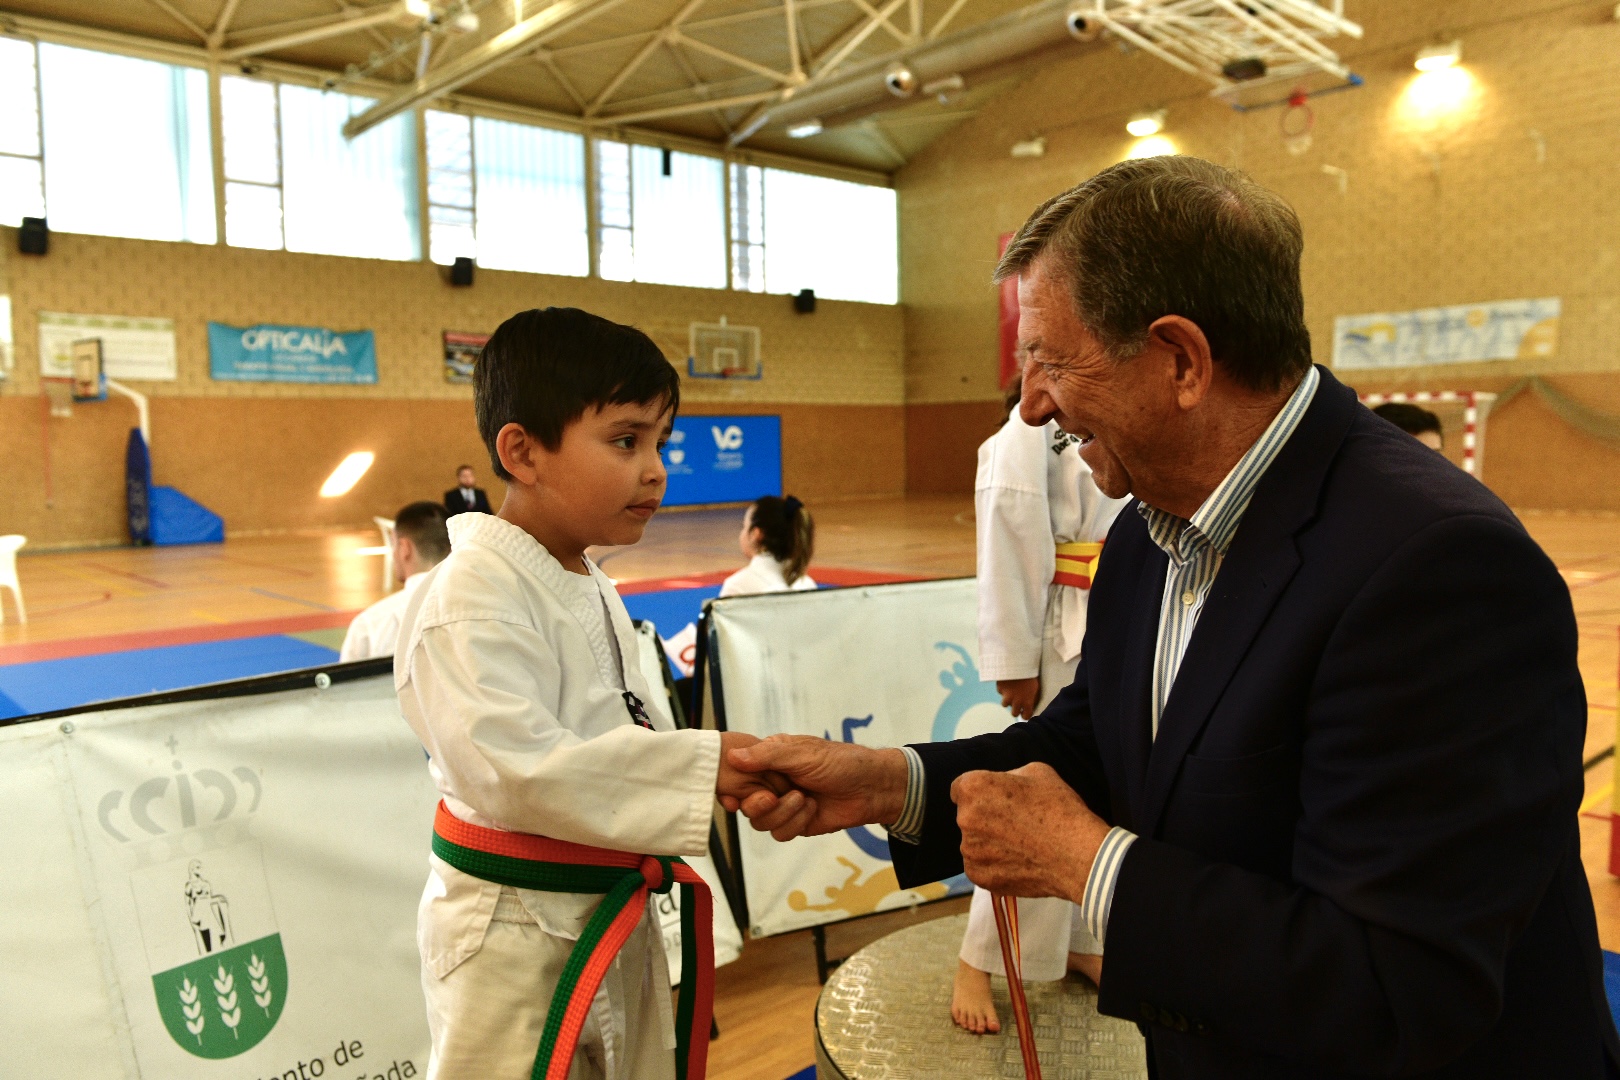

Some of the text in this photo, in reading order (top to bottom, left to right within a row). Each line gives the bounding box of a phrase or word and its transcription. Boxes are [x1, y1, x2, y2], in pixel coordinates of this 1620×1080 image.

[711, 425, 744, 450] VC
[257, 1040, 364, 1080] nto de
